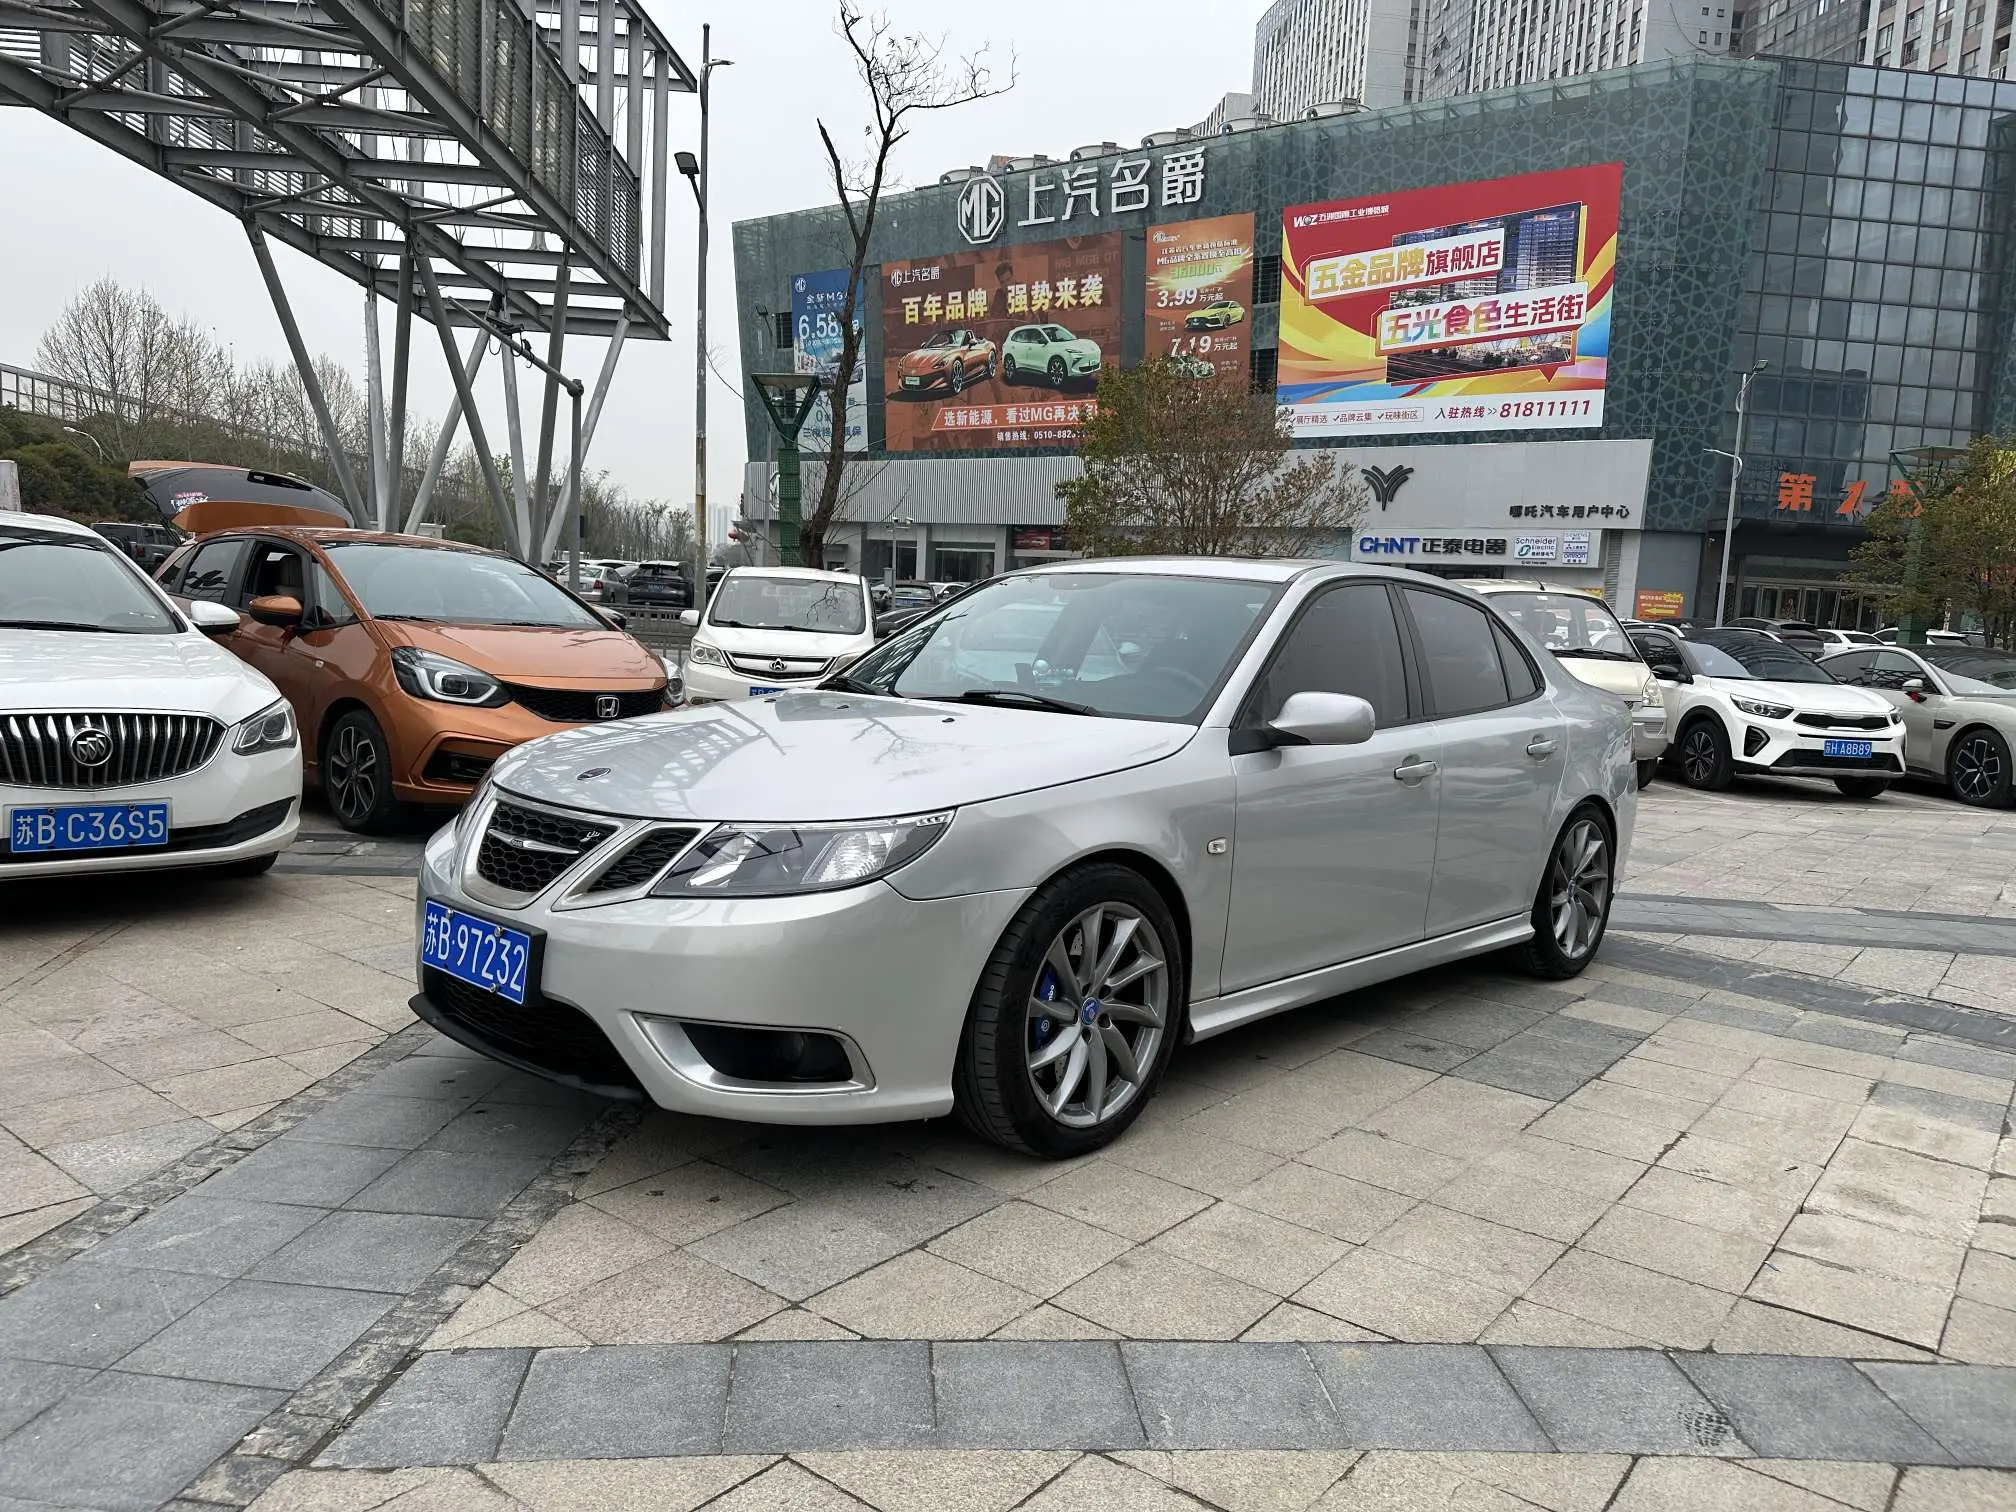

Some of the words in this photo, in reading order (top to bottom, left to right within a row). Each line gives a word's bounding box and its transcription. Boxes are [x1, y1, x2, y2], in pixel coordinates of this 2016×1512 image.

[1017, 146, 1205, 226] 上汽名爵
[961, 183, 1000, 237] MG
[902, 267, 940, 283] 上汽名爵
[1310, 239, 1501, 296] 五金品牌旗舰店
[902, 288, 988, 325] 百年品牌
[1007, 274, 1104, 315] 强势来袭
[1157, 287, 1198, 308] 3.99
[1200, 292, 1224, 302] 万元起
[1383, 293, 1584, 346] 五光食色生活街
[1170, 335, 1212, 357] 7.19
[1214, 342, 1238, 352] 万元起
[1296, 415, 1328, 425] 展厅精选
[1340, 412, 1373, 423] 品牌云集
[1385, 410, 1418, 420] 玩味街区
[1435, 405, 1485, 419] 入驻热线
[1500, 400, 1590, 418] 81811111
[1509, 504, 1631, 520] 哪吒汽车用户中心
[1421, 538, 1507, 556] 正泰电器
